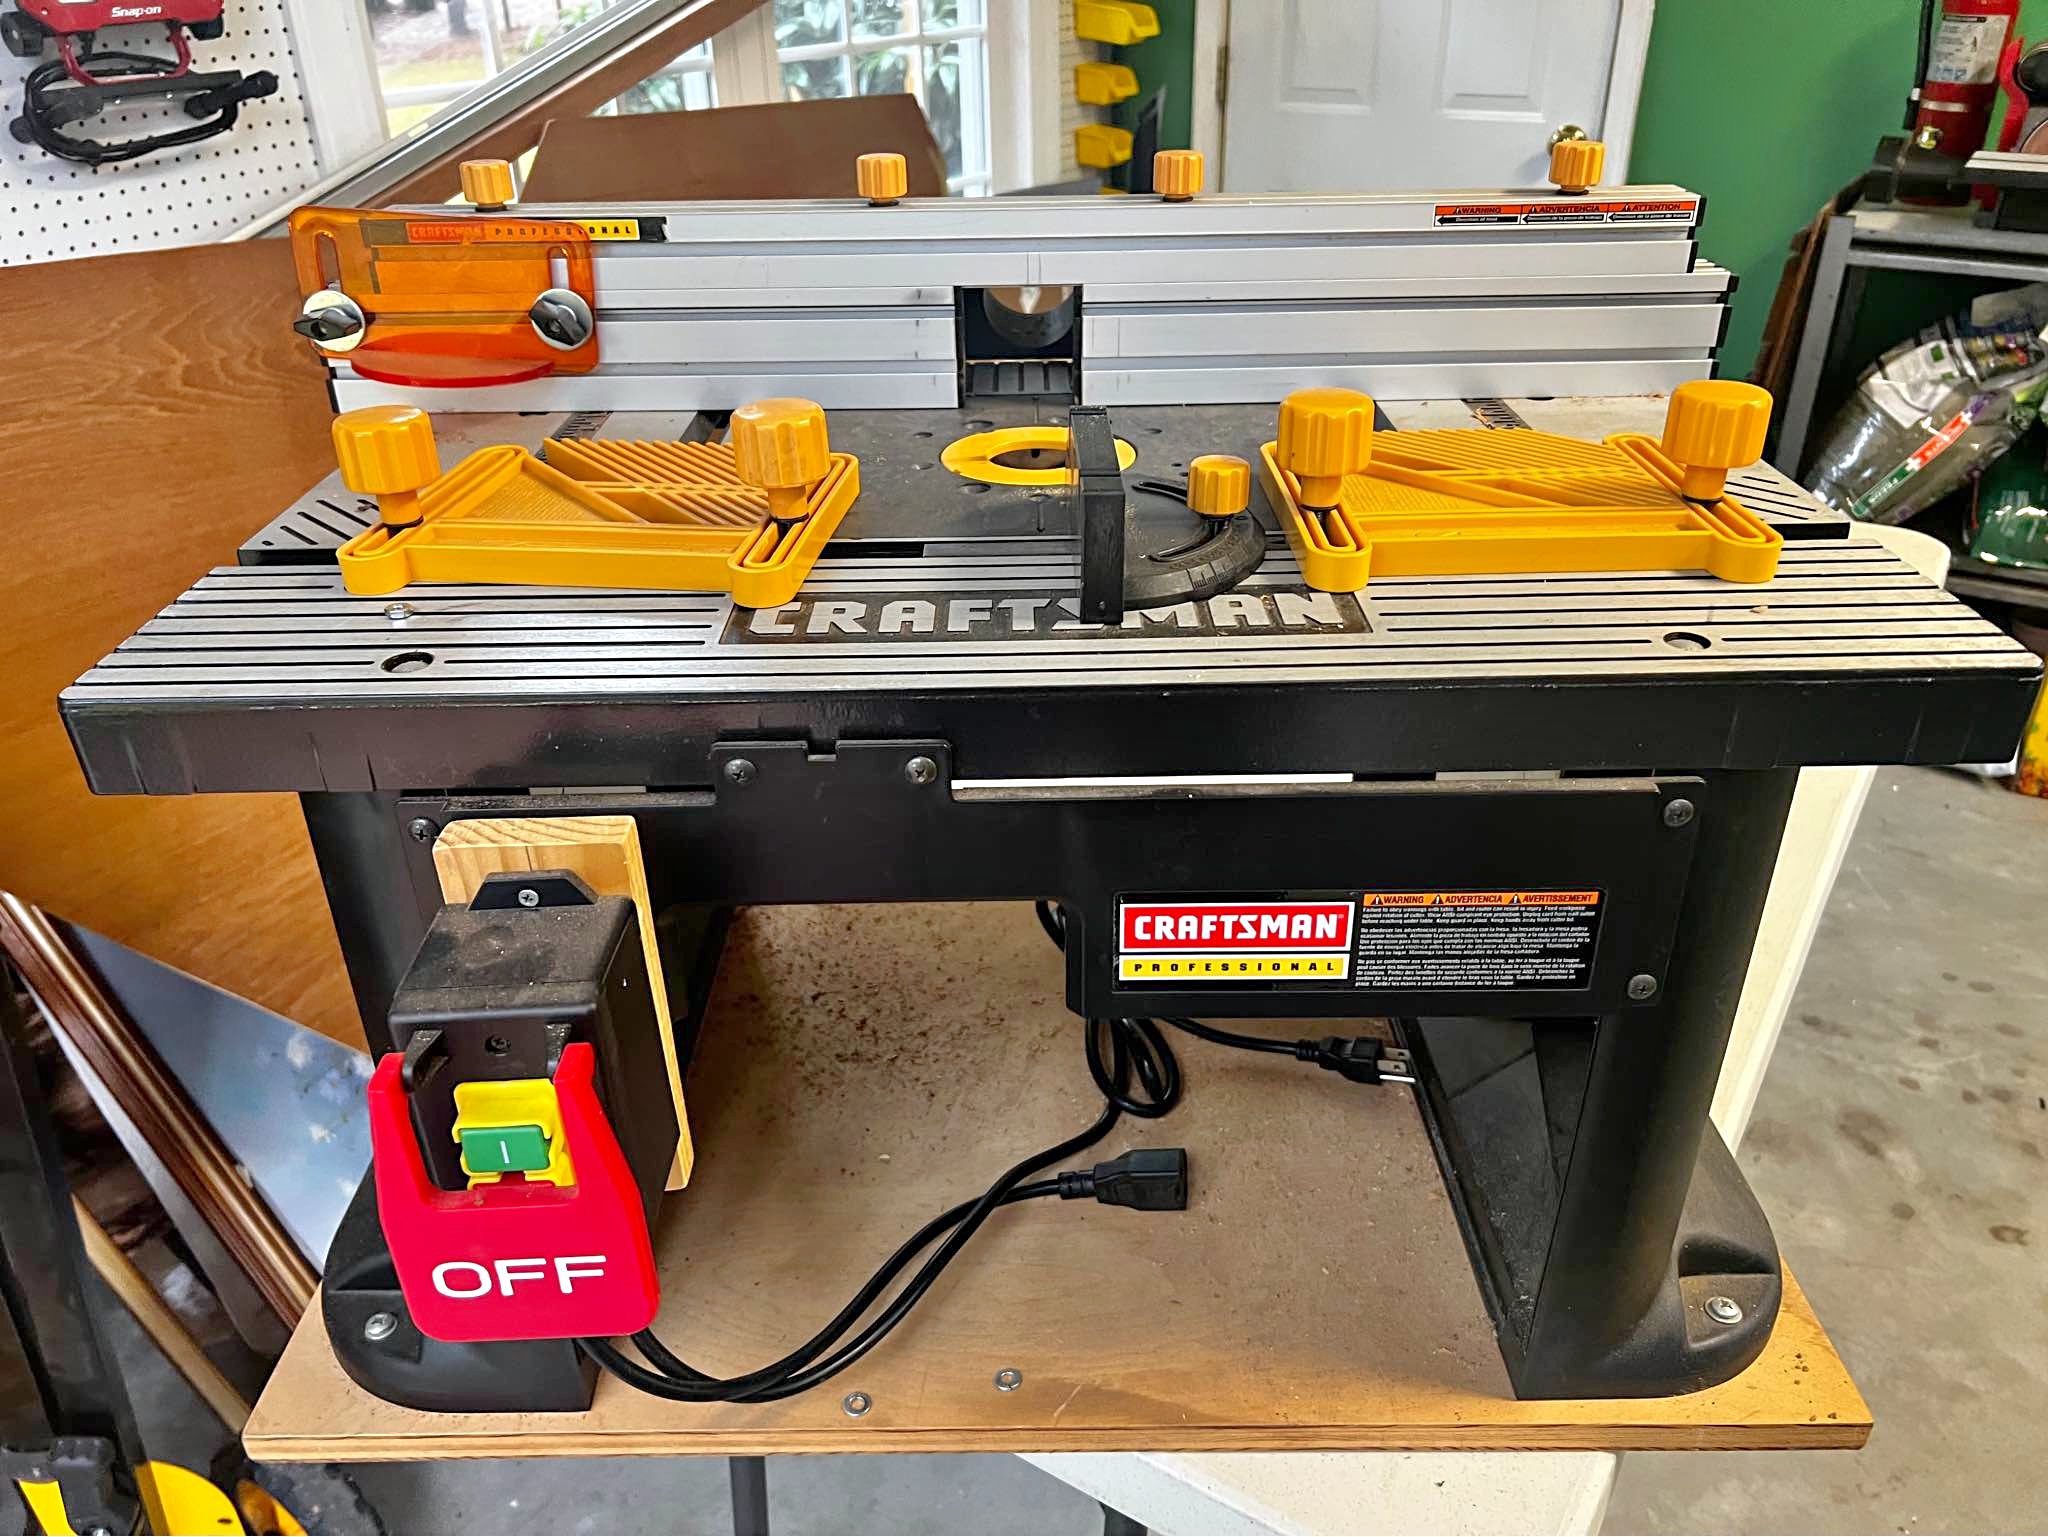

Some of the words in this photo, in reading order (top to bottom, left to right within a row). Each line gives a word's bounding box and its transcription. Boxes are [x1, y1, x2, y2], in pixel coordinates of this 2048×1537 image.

[112, 6, 162, 18] Snap-on
[1461, 207, 1501, 215] WARNING
[1539, 205, 1600, 213] ADVERTENCIA
[1632, 203, 1681, 211] ATTENTION
[1383, 895, 1424, 904] WARNING
[1444, 894, 1501, 903] ADVERTENCIA
[1523, 894, 1593, 903] AVERTISSEMENT
[1134, 913, 1338, 940] CRAFTSMAN
[1134, 962, 1334, 973] PROFESSIONAL
[431, 1255, 607, 1298] OFF
